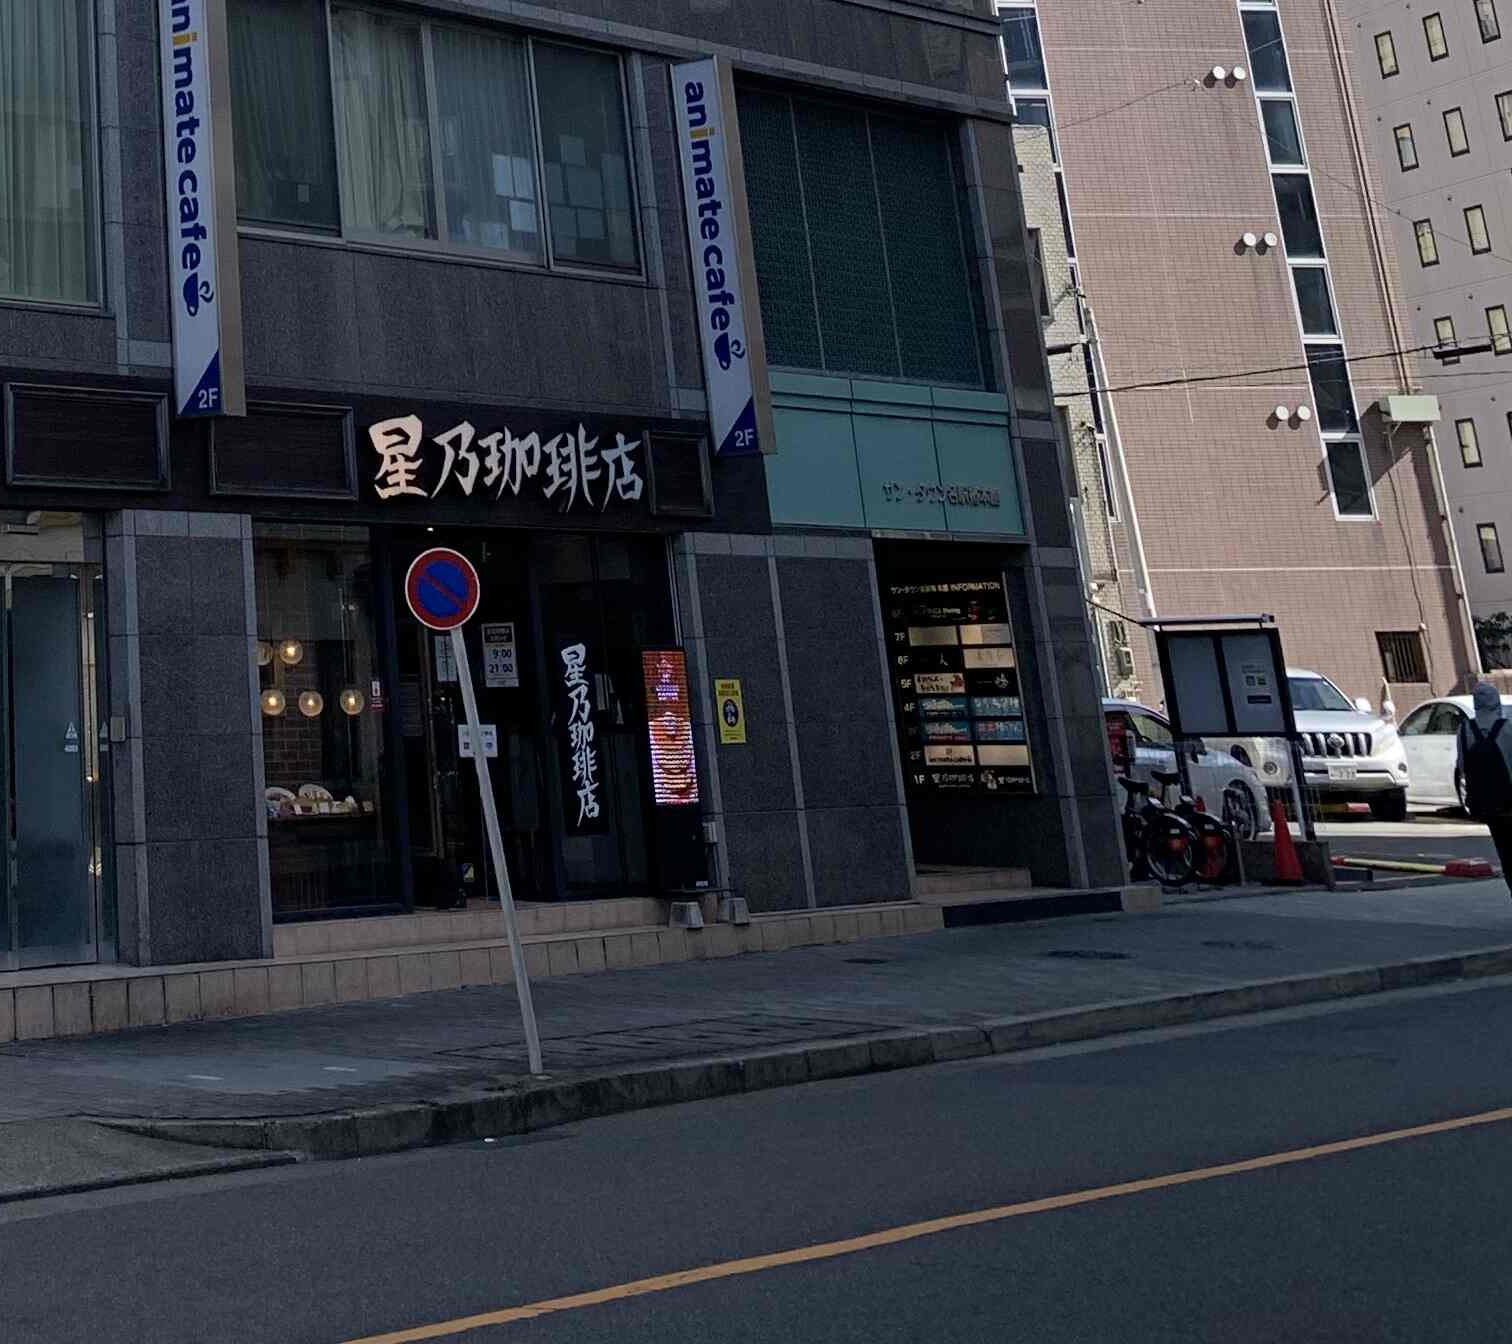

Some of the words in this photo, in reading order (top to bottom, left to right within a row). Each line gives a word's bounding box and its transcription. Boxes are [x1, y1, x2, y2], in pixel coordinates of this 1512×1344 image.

[197, 388, 220, 410] 2F
[734, 429, 753, 448] 2F
[368, 413, 644, 513] 星乃珈琲店
[560, 641, 601, 828] 星乃珈琲店
[914, 774, 925, 785] 1F
